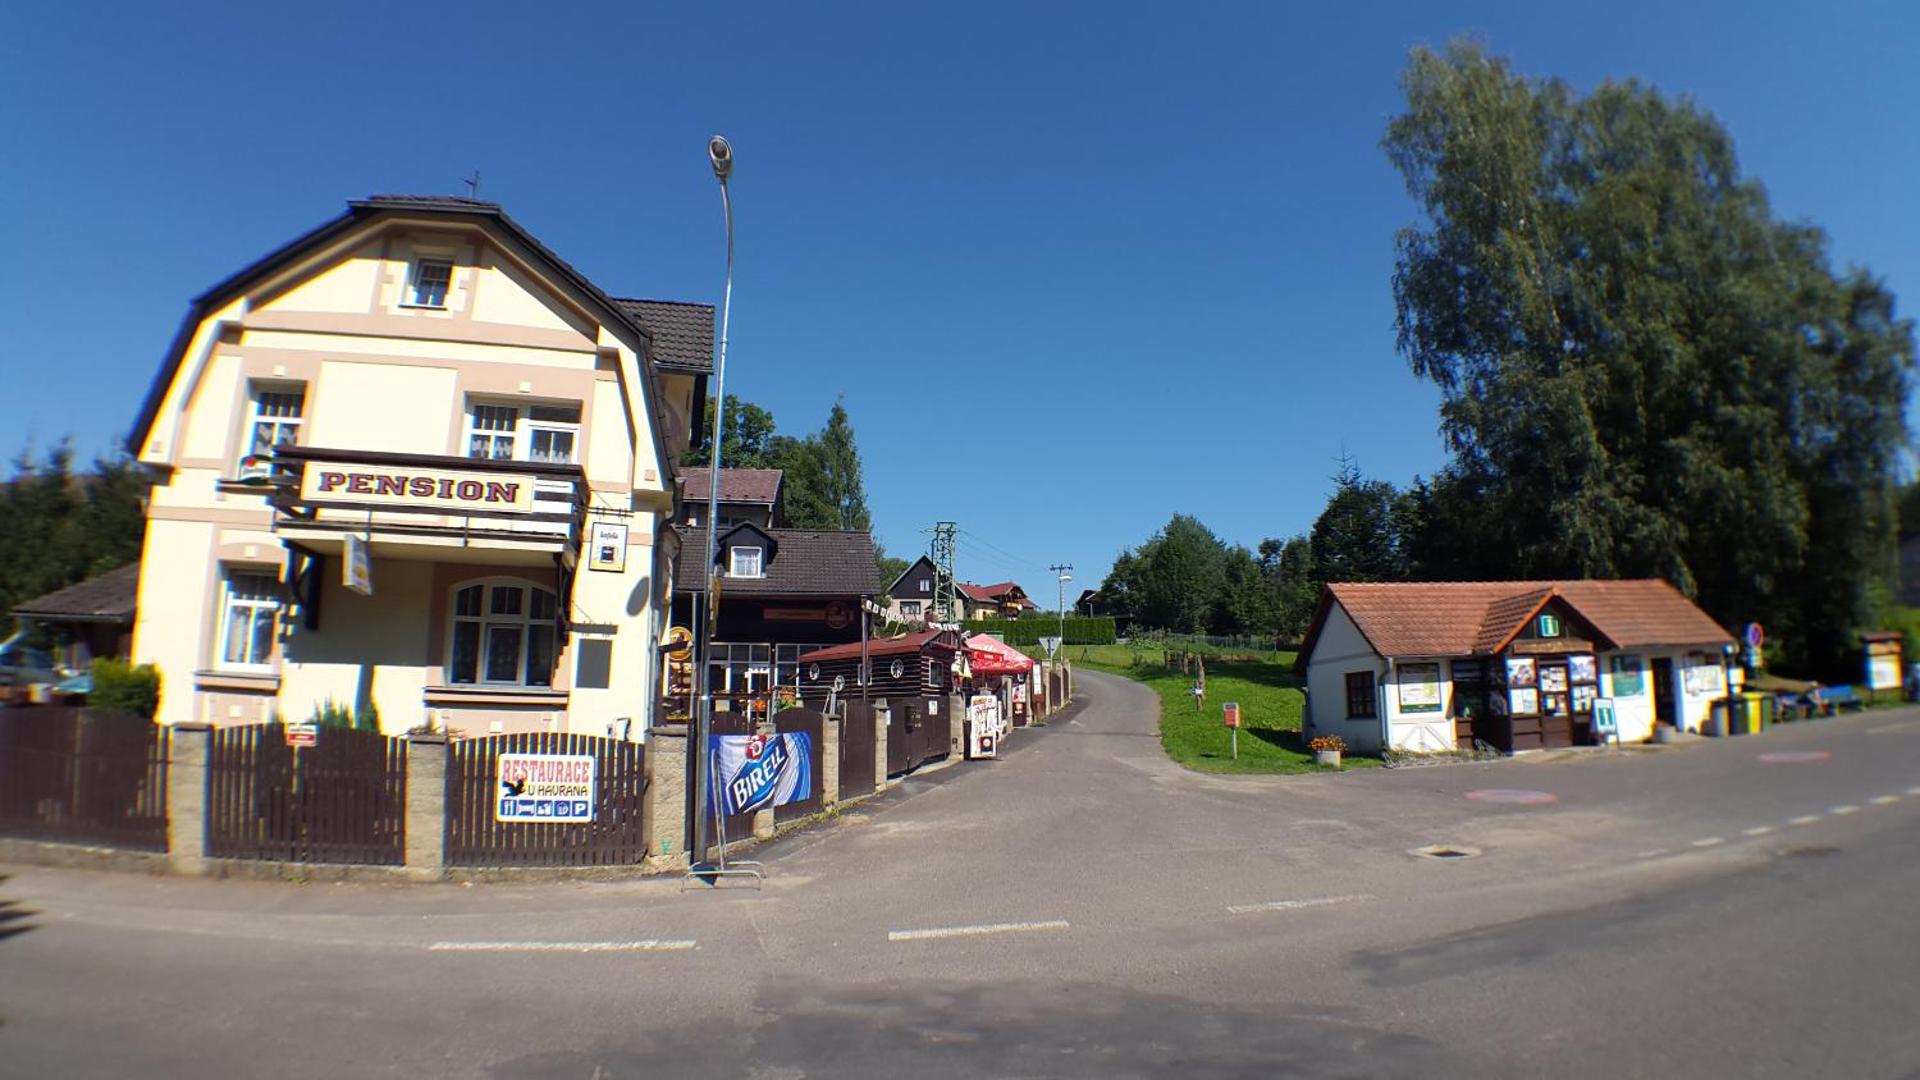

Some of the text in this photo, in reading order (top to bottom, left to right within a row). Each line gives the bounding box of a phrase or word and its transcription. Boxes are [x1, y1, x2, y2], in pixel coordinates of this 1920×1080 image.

[318, 471, 520, 503] PENSION
[503, 759, 590, 783] RESTAURACE
[733, 745, 786, 809] BIRELL
[528, 784, 537, 797] U
